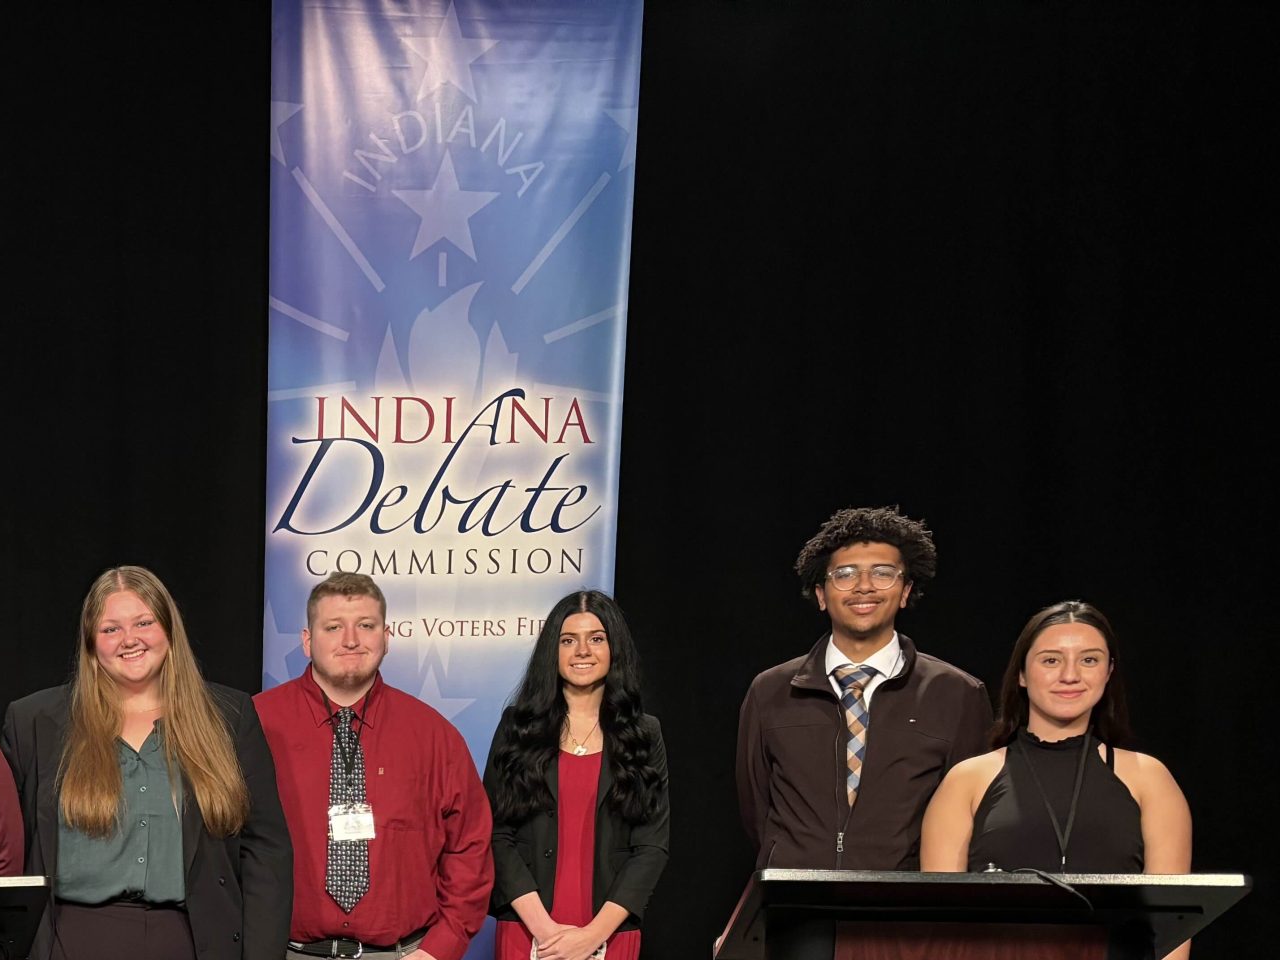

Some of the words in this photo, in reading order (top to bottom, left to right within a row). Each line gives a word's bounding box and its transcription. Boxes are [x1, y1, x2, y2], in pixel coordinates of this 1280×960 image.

[342, 102, 546, 199] INDIANA
[314, 387, 596, 447] INDIANA
[271, 434, 603, 537] Debate
[305, 546, 585, 577] COMMISSION
[422, 618, 506, 637] VOTERS
